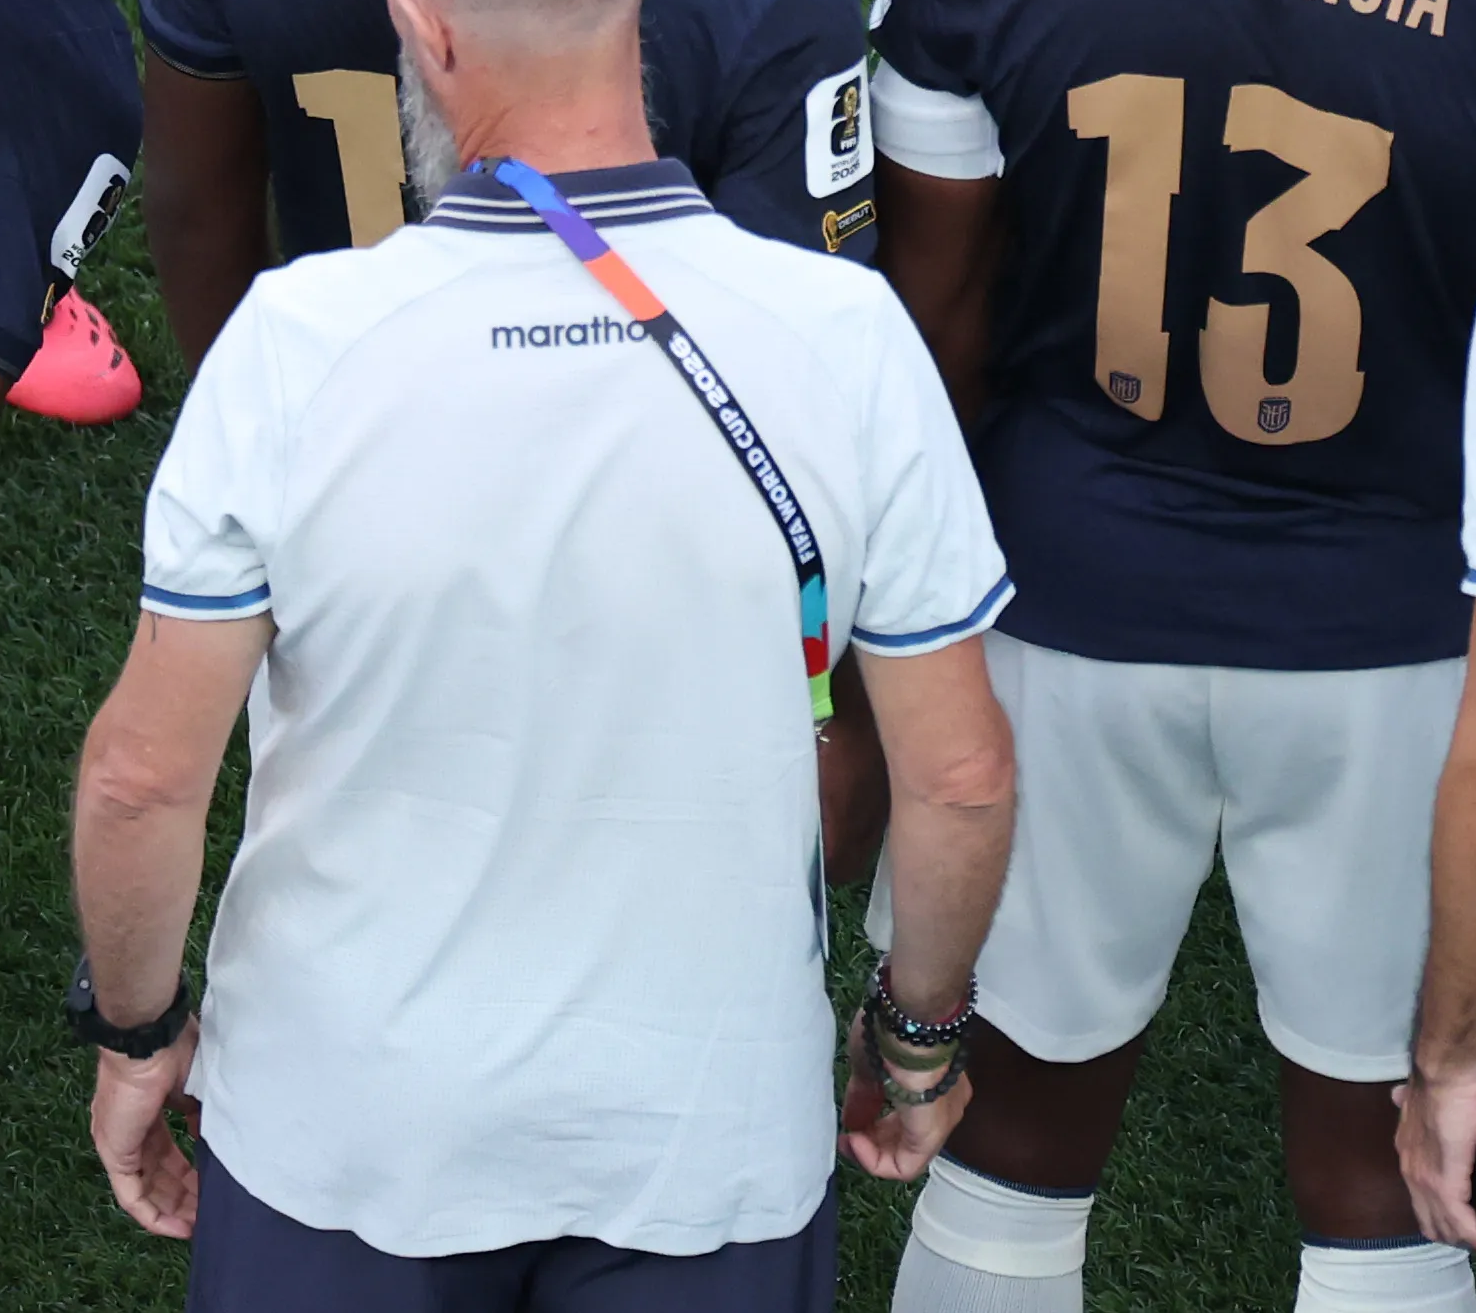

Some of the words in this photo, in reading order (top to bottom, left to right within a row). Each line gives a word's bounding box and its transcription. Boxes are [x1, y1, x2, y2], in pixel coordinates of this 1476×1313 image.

[838, 205, 870, 231] DEBUT
[1067, 73, 1394, 446] 13
[491, 315, 650, 349] maratho
[667, 331, 730, 409] 2026
[719, 406, 755, 451] CUP
[746, 446, 797, 525] WORLD
[787, 516, 817, 566] FIFA
